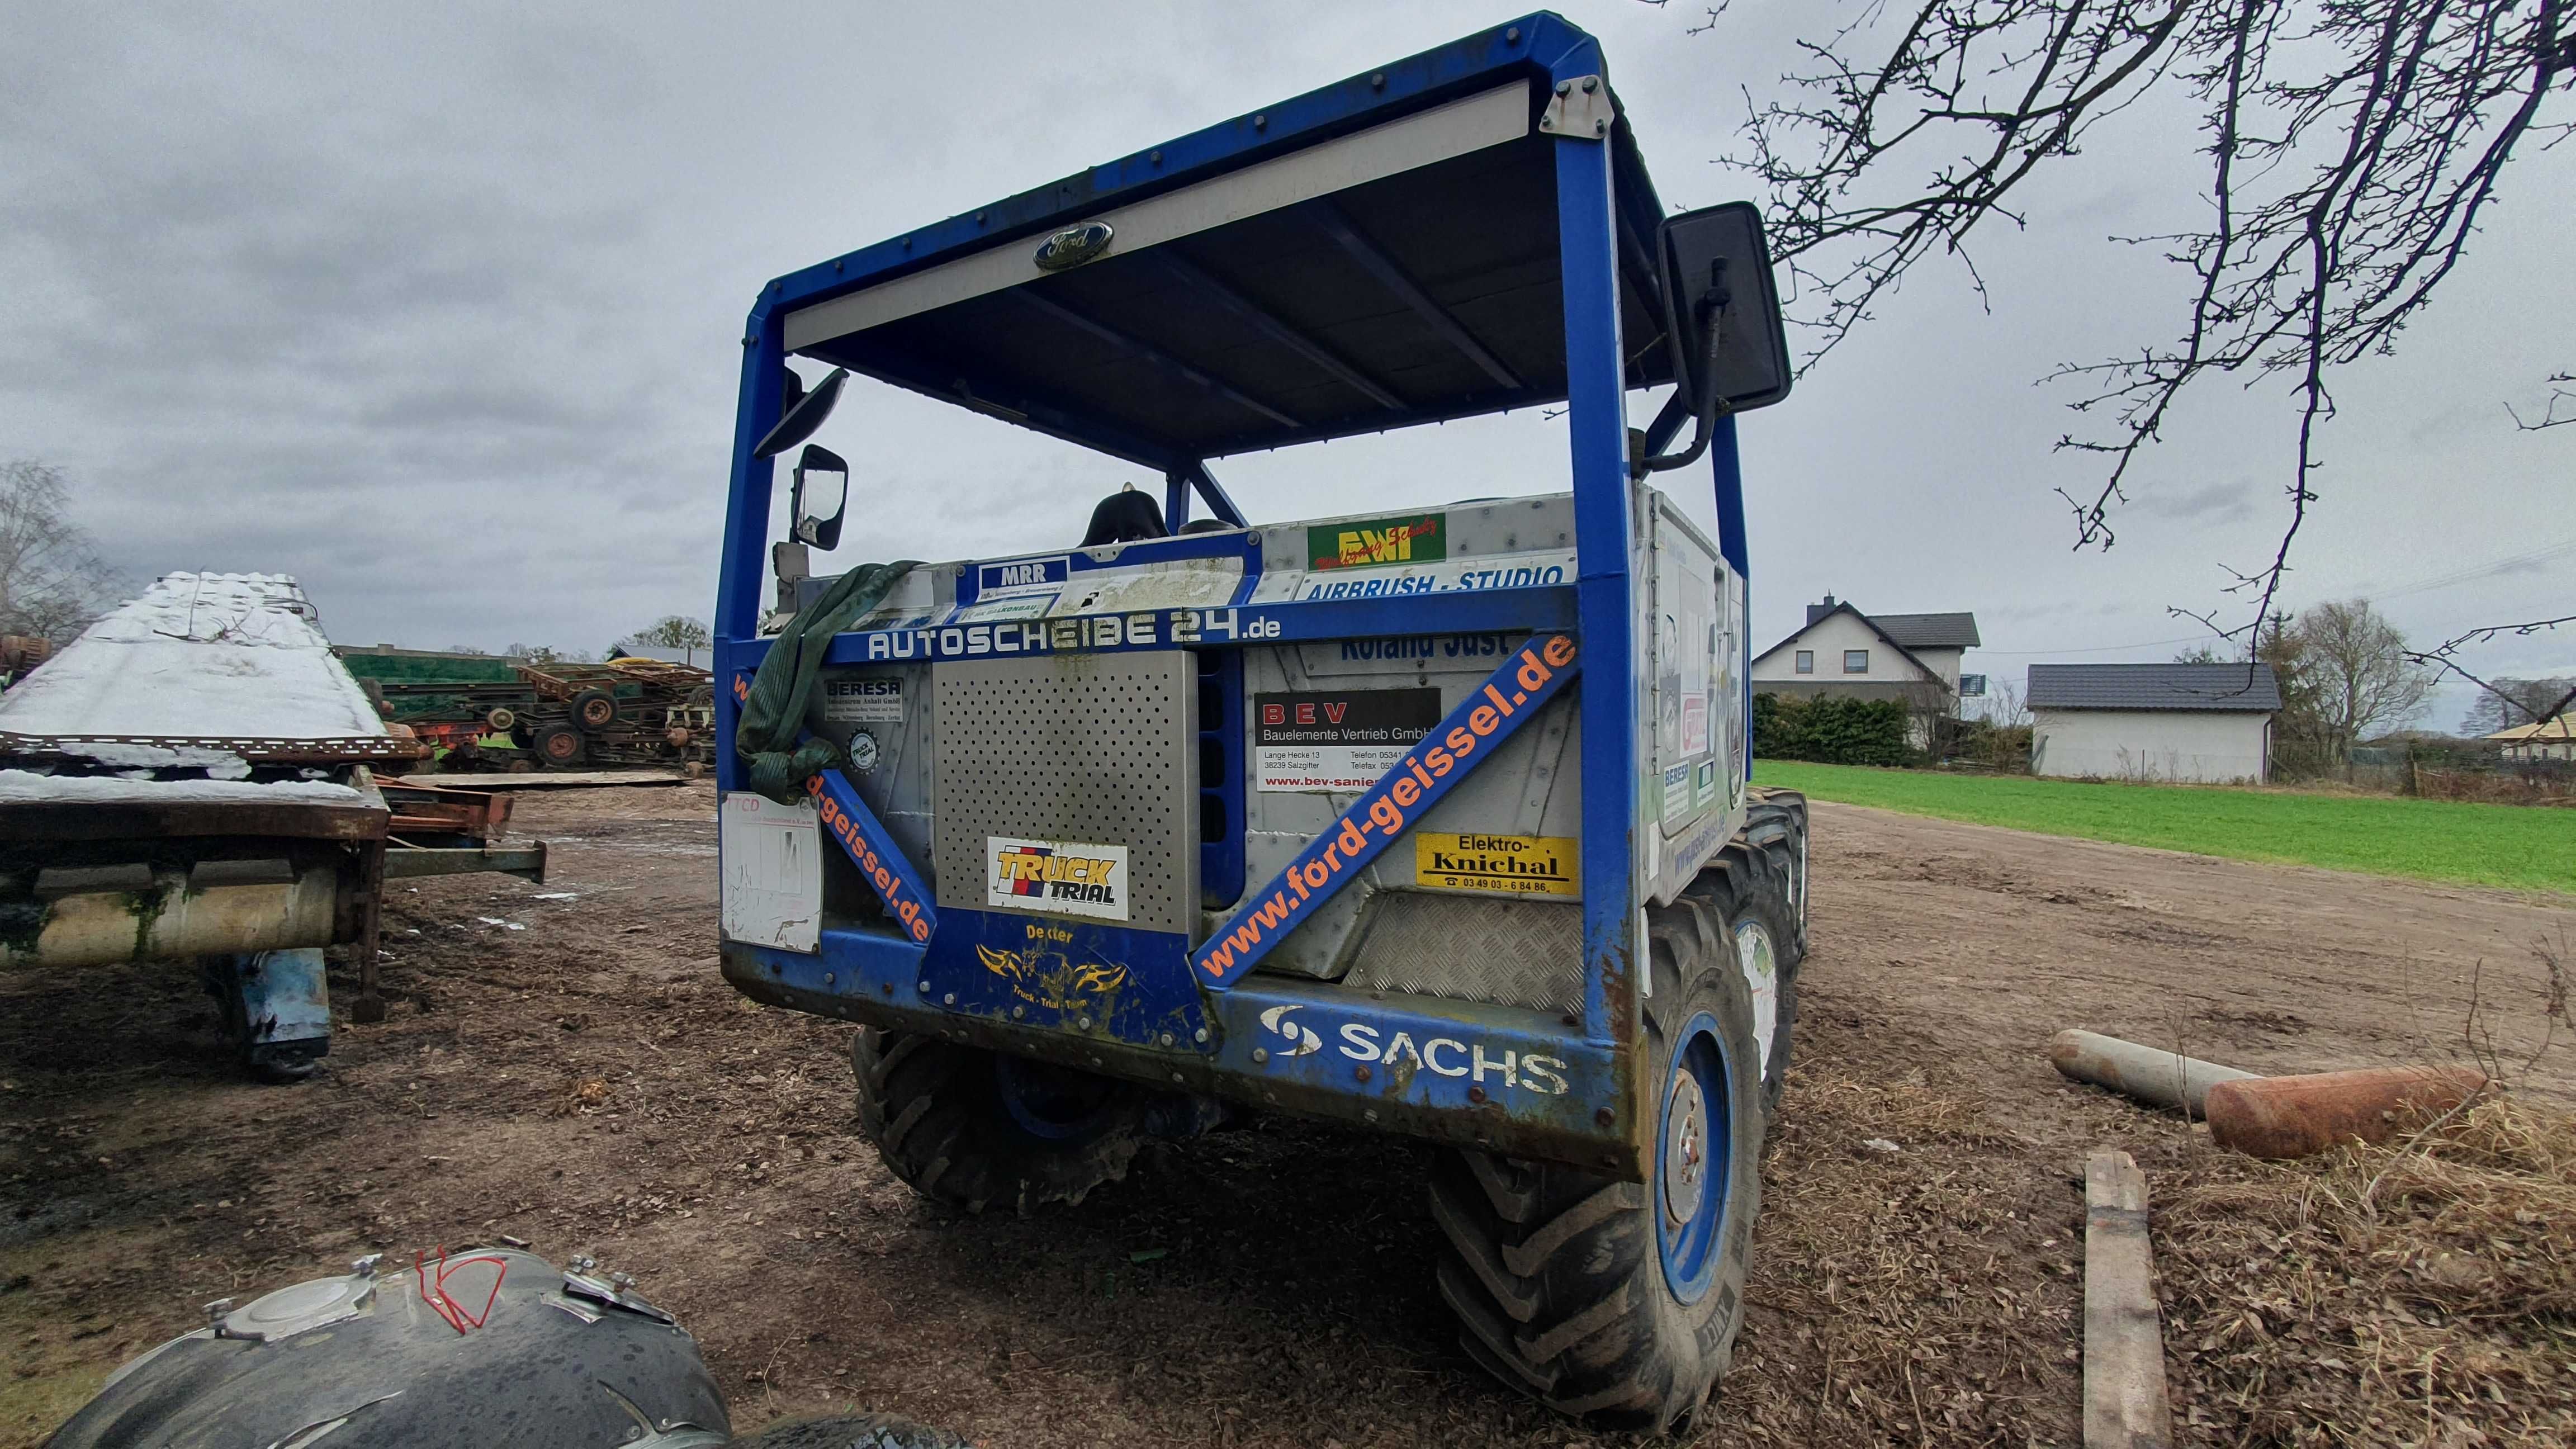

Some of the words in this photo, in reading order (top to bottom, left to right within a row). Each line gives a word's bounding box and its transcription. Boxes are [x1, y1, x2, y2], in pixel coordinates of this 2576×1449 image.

[1047, 228, 1090, 257] Ford
[1001, 564, 1046, 586] MRR
[1306, 575, 1435, 600] AIRBRUSH
[1458, 568, 1564, 590] STUDIO
[868, 613, 1157, 660] AUTOSCHEIBE
[1342, 635, 1435, 660] Roland
[1444, 632, 1509, 657] Just
[827, 681, 901, 695] BERESA
[1263, 728, 1338, 741] Bauelemente
[1342, 727, 1389, 740] Vertrieb
[853, 742, 868, 756] TRUCK
[859, 747, 874, 759] TRIAL
[1265, 751, 1286, 760] Lange
[1288, 762, 1319, 770] Salzgitter
[1665, 764, 1688, 787] BERESA
[1200, 635, 1576, 977] www.ford-geissel.de
[1459, 836, 1530, 853] Elektro-
[998, 851, 1117, 885] TRUCK
[1433, 852, 1559, 875] Knichal
[1050, 880, 1116, 906] TRIAL
[1464, 878, 1474, 887] 03
[1478, 879, 1488, 888] 49
[1491, 880, 1502, 889] 03
[1520, 882, 1531, 891] 84
[1014, 984, 1035, 1002] Truck
[1041, 997, 1059, 1008] Trial
[1339, 1024, 1568, 1094] SACHS
